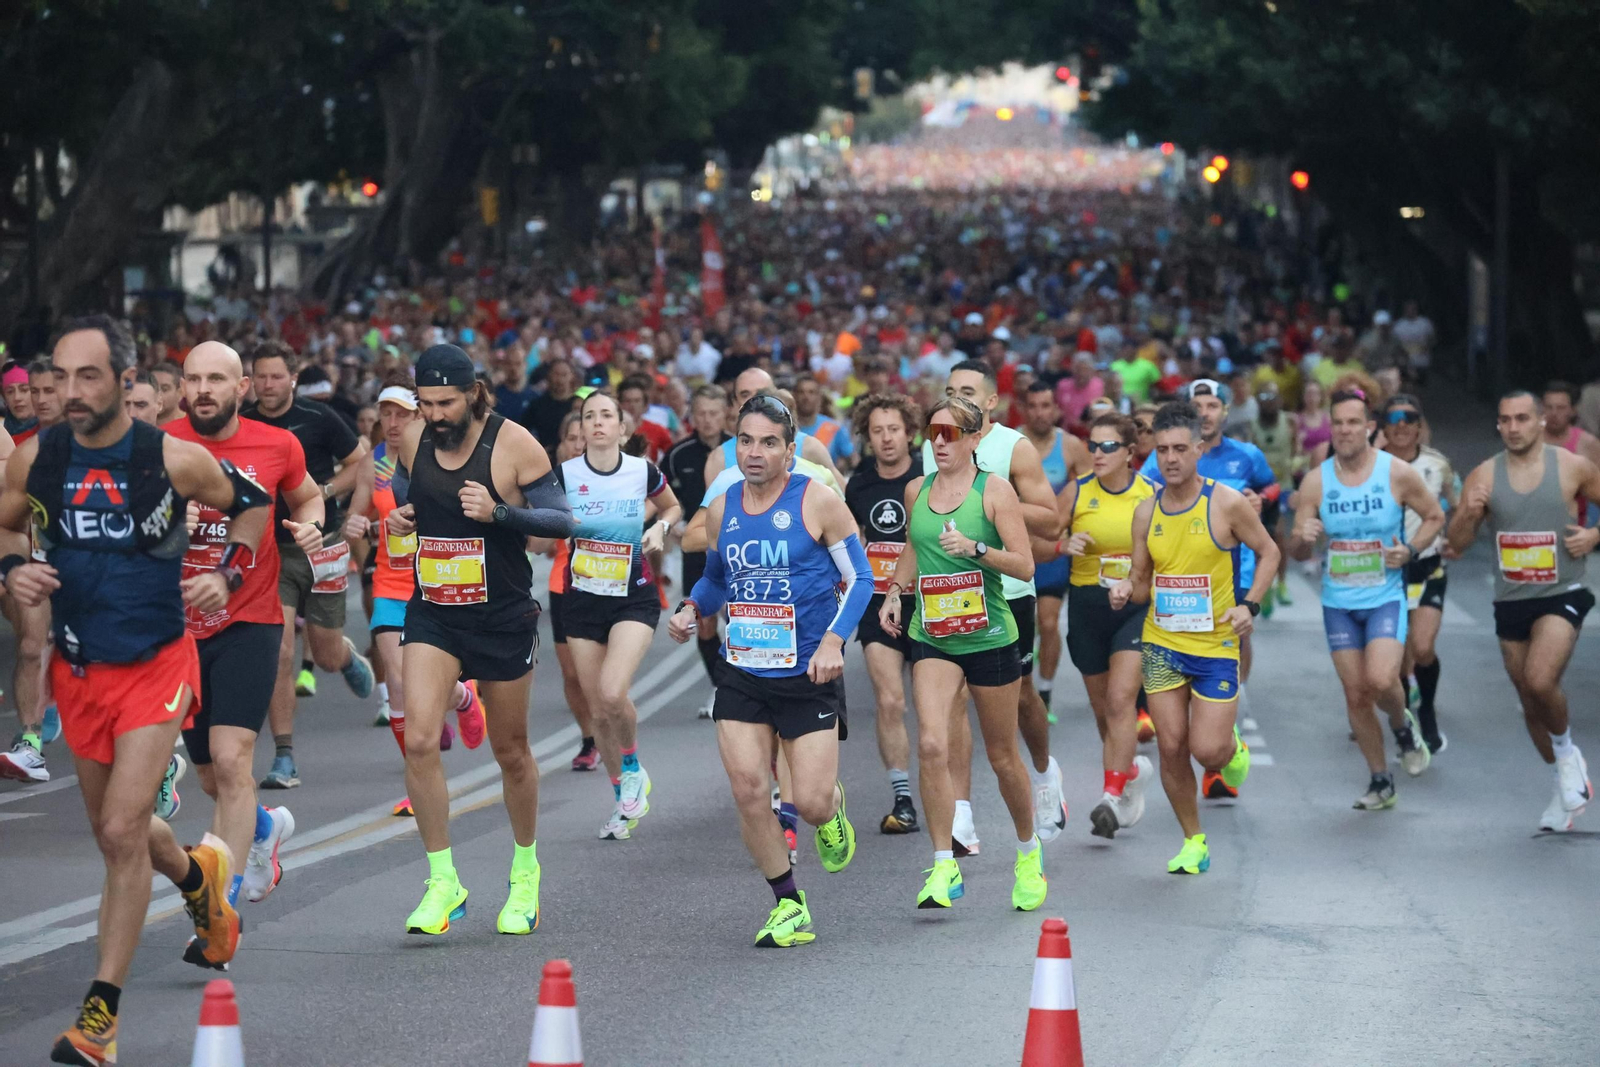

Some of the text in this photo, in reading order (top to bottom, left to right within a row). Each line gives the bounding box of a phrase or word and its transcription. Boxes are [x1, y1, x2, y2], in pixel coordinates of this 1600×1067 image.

[1328, 494, 1384, 515] nerja
[198, 522, 227, 537] 746
[433, 541, 478, 552] GENERALI
[726, 540, 789, 572] RCM
[435, 562, 460, 575] 947
[933, 574, 978, 588] GENERALI
[1166, 578, 1205, 587] GENERALI
[730, 579, 792, 601] 1873
[939, 595, 962, 609] 827
[1164, 596, 1197, 608] 17699
[744, 606, 788, 617] GENERALI
[738, 626, 779, 640] 12502
